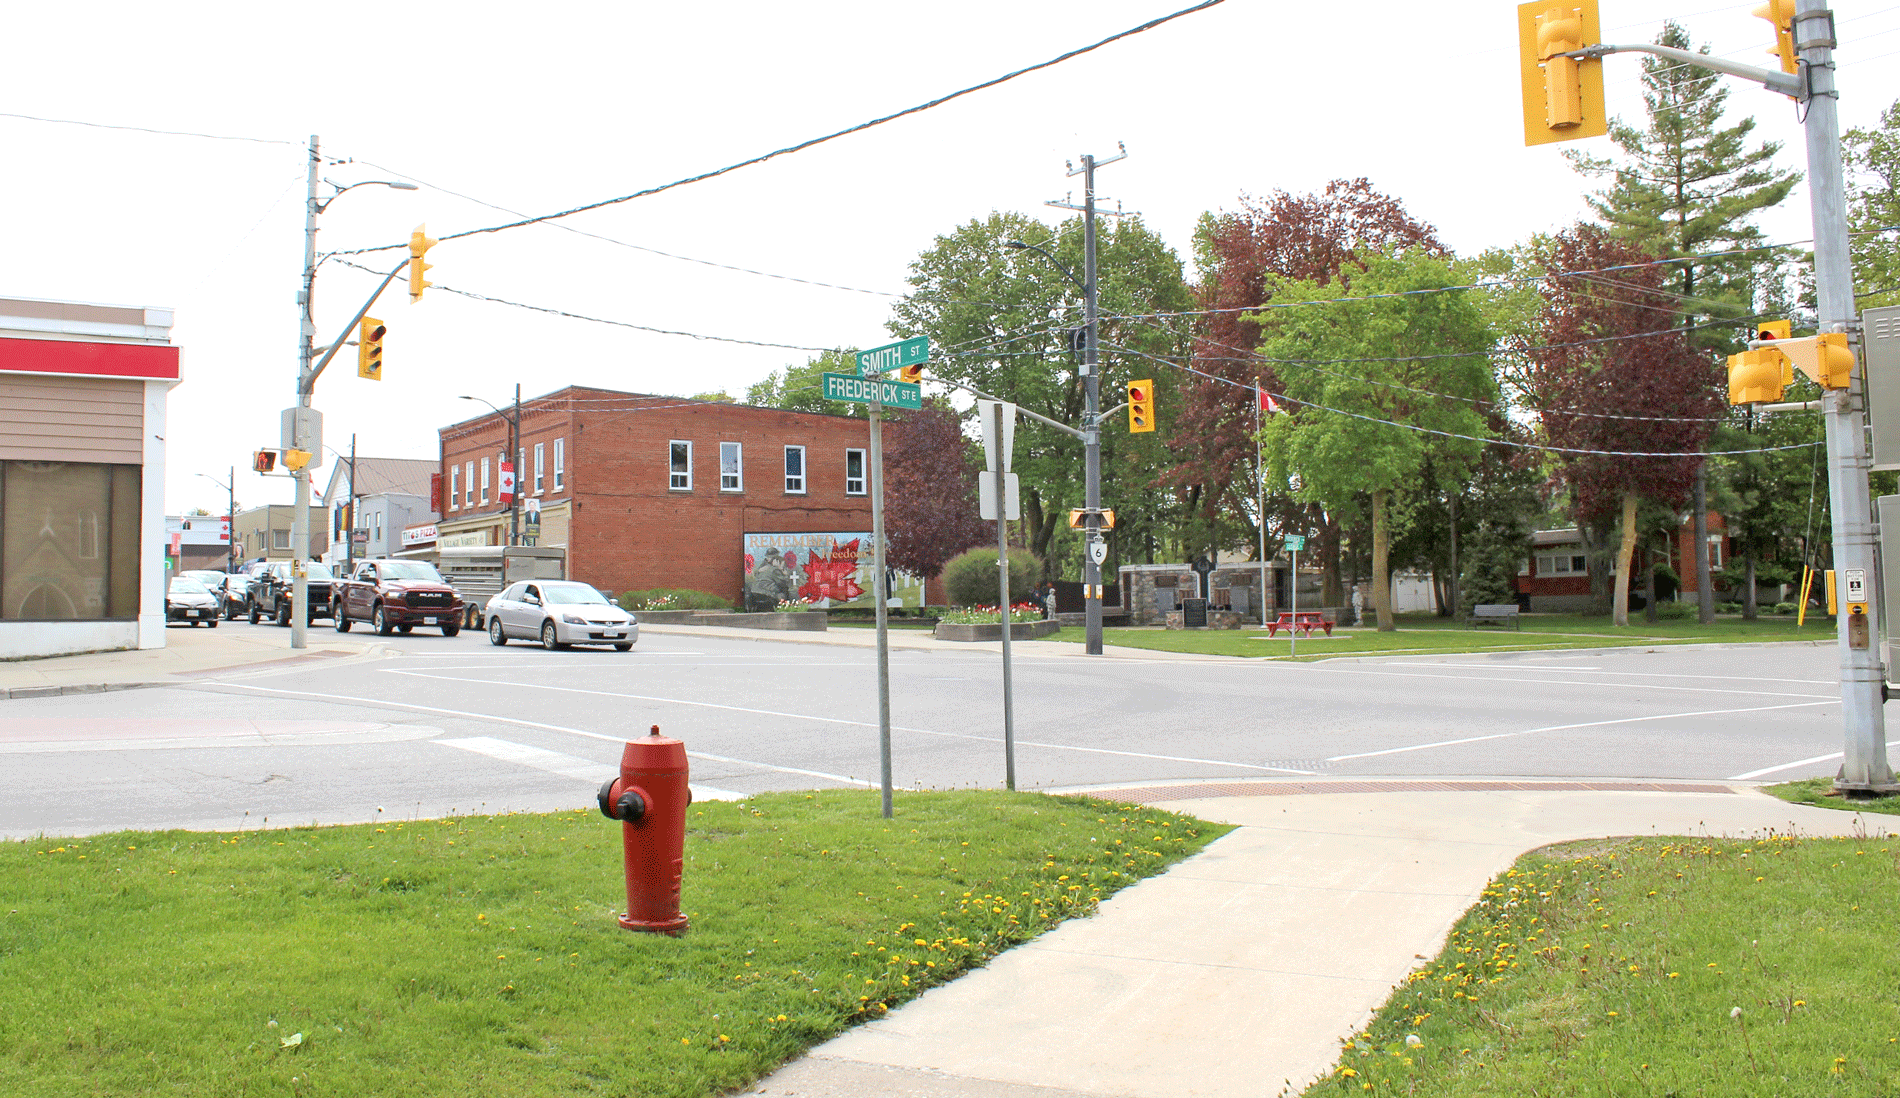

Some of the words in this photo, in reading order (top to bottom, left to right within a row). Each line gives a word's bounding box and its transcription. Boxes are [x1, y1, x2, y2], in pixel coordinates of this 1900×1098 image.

[861, 345, 901, 373] SMITH
[910, 345, 920, 357] ST
[828, 377, 898, 403] FREDERICK
[901, 389, 911, 400] ST
[911, 390, 917, 401] E
[420, 527, 437, 537] PIZZA
[822, 547, 867, 559] Freedom
[1095, 548, 1102, 558] 6
